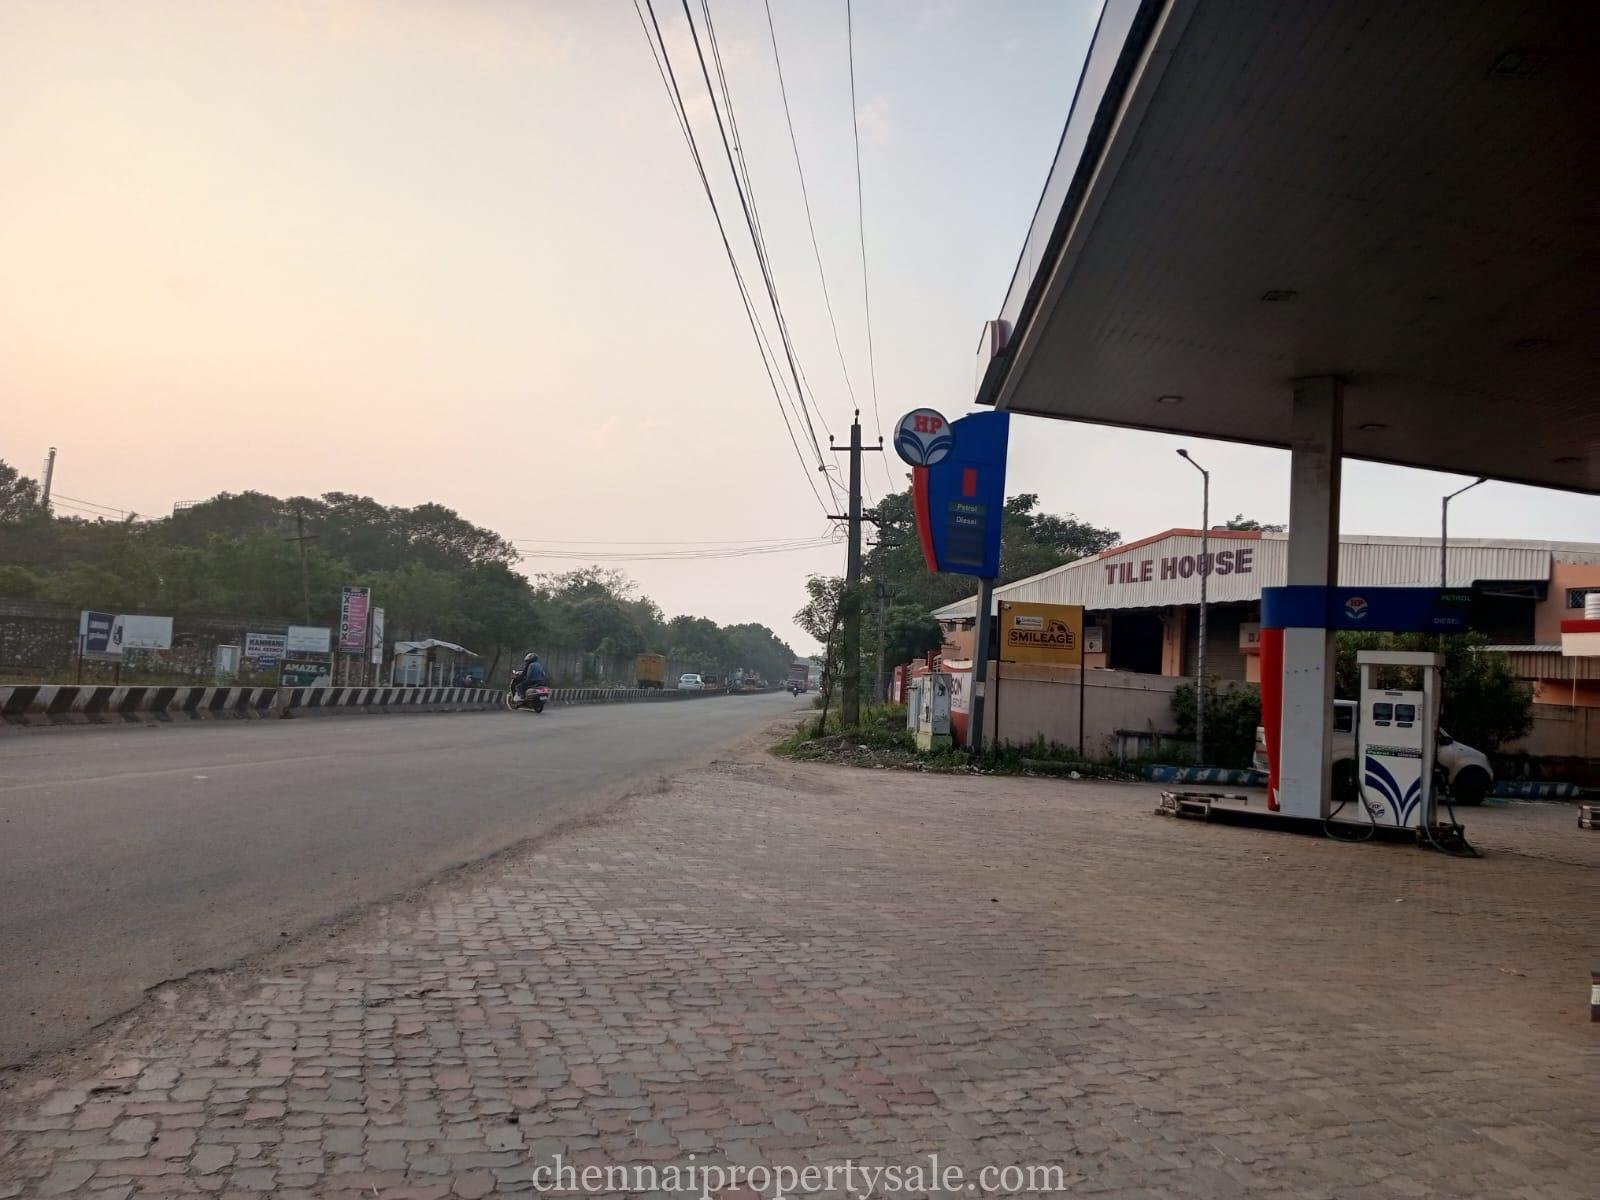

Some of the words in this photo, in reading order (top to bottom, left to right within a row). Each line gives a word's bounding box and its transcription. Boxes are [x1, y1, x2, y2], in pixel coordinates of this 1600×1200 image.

[914, 415, 943, 435] HP
[957, 503, 978, 512] Petrol
[956, 515, 977, 525] Diesel
[1105, 559, 1153, 585] TILE
[1160, 548, 1253, 581] HOUSE
[341, 595, 350, 641] XEROX
[1010, 631, 1073, 644] SMILEAGE
[285, 664, 317, 673] AMAZE
